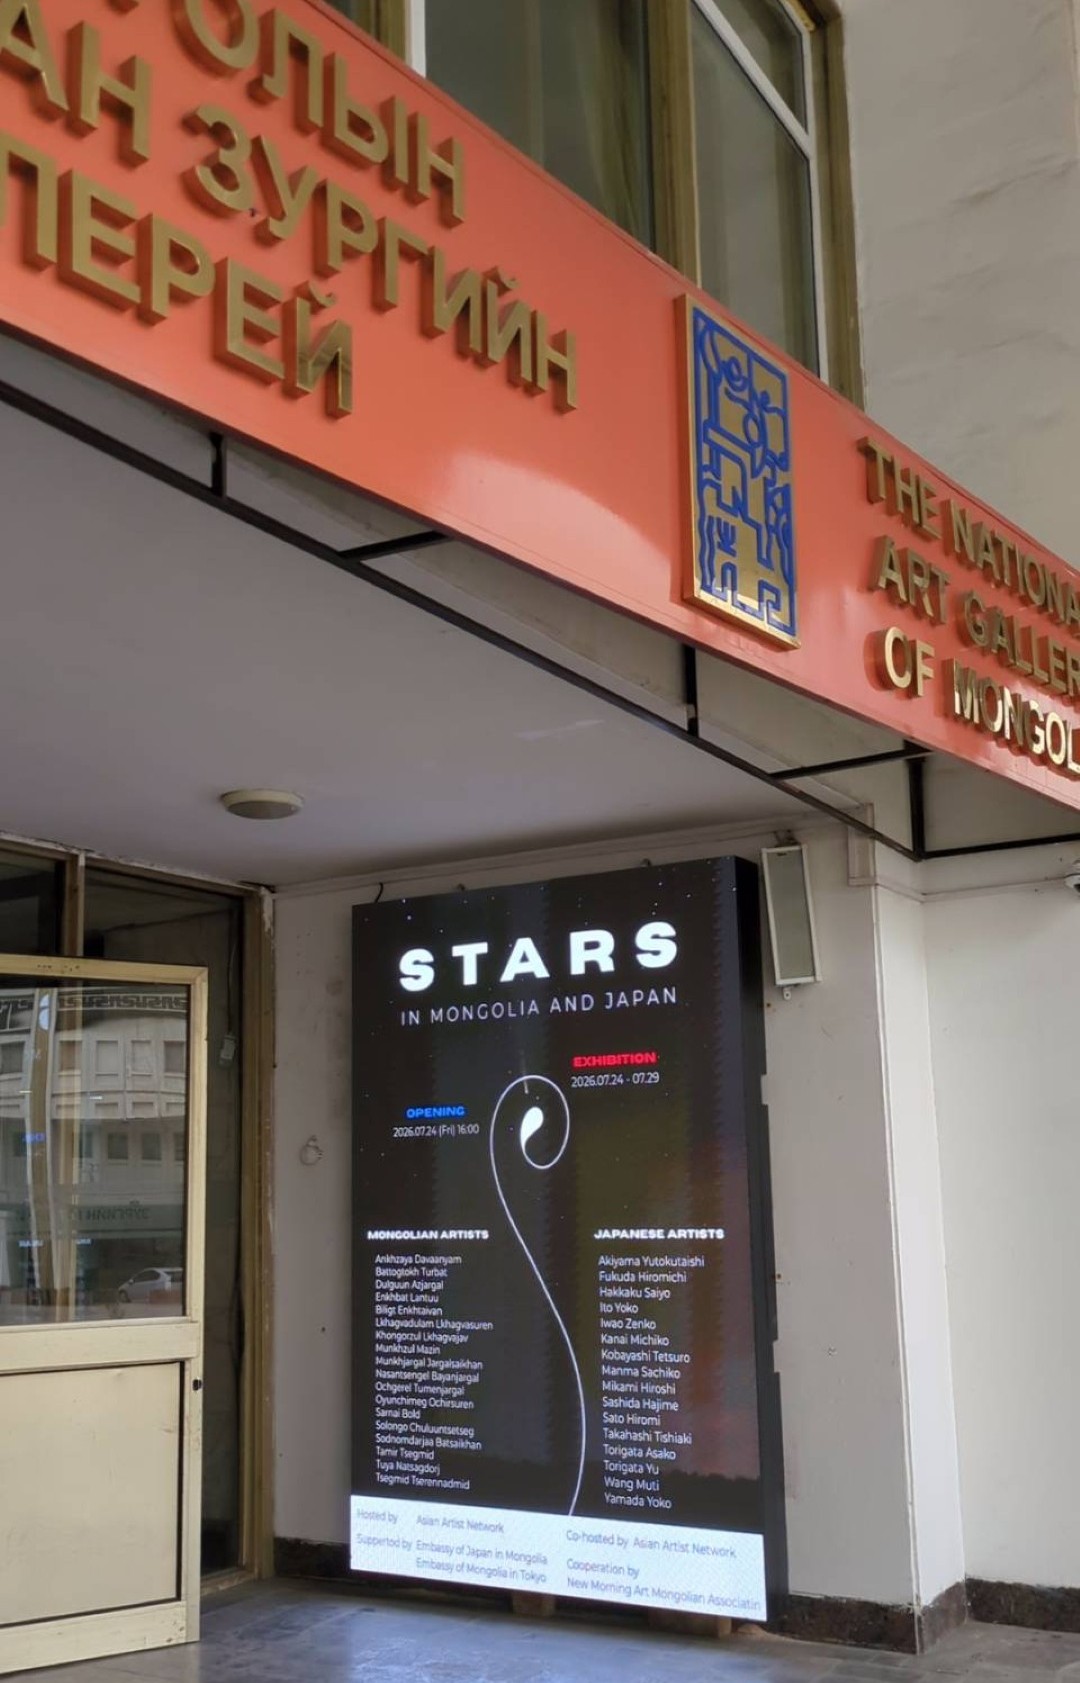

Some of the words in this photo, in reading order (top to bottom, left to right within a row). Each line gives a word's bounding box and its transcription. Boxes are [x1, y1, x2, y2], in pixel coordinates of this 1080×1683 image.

[105, 0, 466, 227] ОЛЫН
[183, 105, 577, 412] ЗУРГИЙН
[858, 436, 942, 542] THE
[941, 498, 1080, 627] NATIONA
[869, 535, 950, 626] ART
[957, 590, 1080, 698] GALLER
[874, 626, 935, 698] OF
[945, 656, 1080, 776] MONGOL
[399, 921, 679, 992] STARS
[400, 1010, 421, 1026] IN
[430, 1000, 541, 1025] MONGOLIA
[549, 993, 595, 1014] AND
[604, 986, 678, 1010] JAPAN
[572, 1051, 659, 1069] EXHIBITION
[570, 1074, 625, 1088] 2026.07.24
[632, 1071, 661, 1086] 07.29
[405, 1105, 467, 1120] OPENING
[392, 1124, 436, 1138] 2026.07.24
[438, 1122, 456, 1138] (Fri)
[457, 1122, 480, 1136] 16:00
[367, 1230, 438, 1240] MONGOLIAN
[440, 1230, 489, 1240] ARTISTS
[594, 1229, 665, 1239] JAPANESE
[667, 1229, 725, 1239] ARTISTS
[599, 1256, 640, 1269] Akiyama
[642, 1256, 705, 1267] Yutokutaishi
[599, 1271, 635, 1282] Fukuda
[639, 1271, 687, 1283] Hiromichi
[375, 1280, 410, 1290] Dulguun
[375, 1292, 408, 1302] Enkhbat
[600, 1287, 642, 1298] Hakkaku
[644, 1288, 671, 1300] Saiyo
[600, 1303, 613, 1313] Ito
[614, 1303, 639, 1313] Yoko
[436, 1319, 493, 1331] Lkhagvasuren
[601, 1318, 623, 1328] Iwao
[625, 1318, 656, 1330] Zenko
[375, 1331, 421, 1342] Khongorzul
[601, 1334, 628, 1344] Kanai
[630, 1334, 669, 1346] Michiko
[375, 1356, 426, 1369] Munkhjargal
[602, 1349, 650, 1363] Kobayashi
[652, 1350, 690, 1363] Tetsuro
[431, 1371, 480, 1385] Bayanjargal
[641, 1366, 681, 1379] Sachiko
[602, 1381, 638, 1392] Mikami
[641, 1382, 676, 1395] Hiroshi
[603, 1396, 640, 1409] Sashida
[643, 1398, 679, 1413] Hajime
[603, 1412, 624, 1424] Sato
[626, 1413, 661, 1426] Hiromi
[375, 1420, 408, 1433] Solongo
[603, 1427, 652, 1441] Takahashi
[435, 1437, 482, 1450] Batsaikhan
[603, 1443, 643, 1459] Torigata
[645, 1447, 676, 1460] Asako
[375, 1459, 394, 1471] Tuya
[603, 1460, 644, 1475] Torigata
[646, 1463, 659, 1475] Yu
[604, 1476, 634, 1491] Wang
[604, 1492, 645, 1506] Yamada
[647, 1496, 672, 1509] Yoko
[388, 1511, 398, 1524] by
[617, 1533, 628, 1549] by
[456, 1544, 465, 1555] of
[466, 1545, 492, 1559] Japan
[495, 1547, 504, 1560] in
[506, 1550, 547, 1565] Mongolia
[456, 1561, 465, 1572] of
[467, 1563, 507, 1578] Mongolia
[509, 1567, 518, 1579] in
[520, 1569, 546, 1583] Tokyo
[567, 1558, 625, 1575] Cooperation
[627, 1563, 639, 1579] by
[567, 1577, 588, 1588] New
[591, 1580, 632, 1597] Morning
